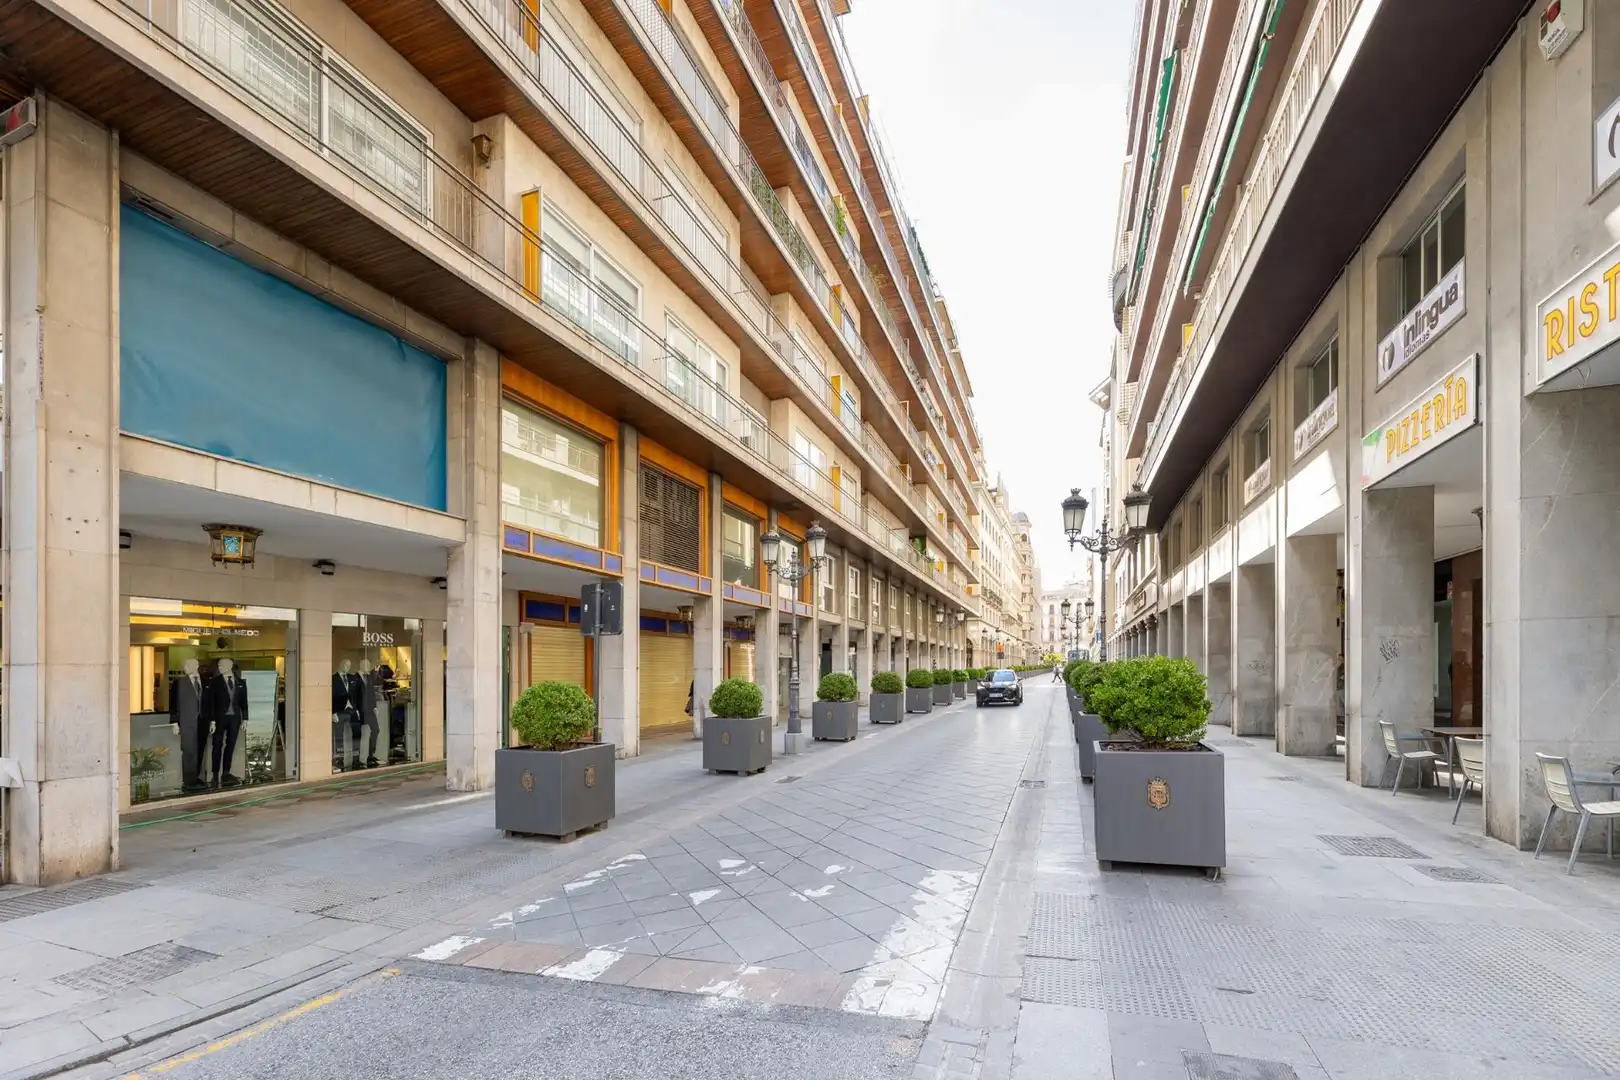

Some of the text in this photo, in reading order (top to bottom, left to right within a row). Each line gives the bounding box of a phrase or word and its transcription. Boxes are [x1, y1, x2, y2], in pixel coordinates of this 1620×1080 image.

[1403, 281, 1459, 349] inlingua
[1403, 330, 1430, 360] idiomas
[1544, 261, 1620, 362] RIST
[1385, 374, 1467, 464] PIZZERÍA
[363, 632, 394, 644] BOSS
